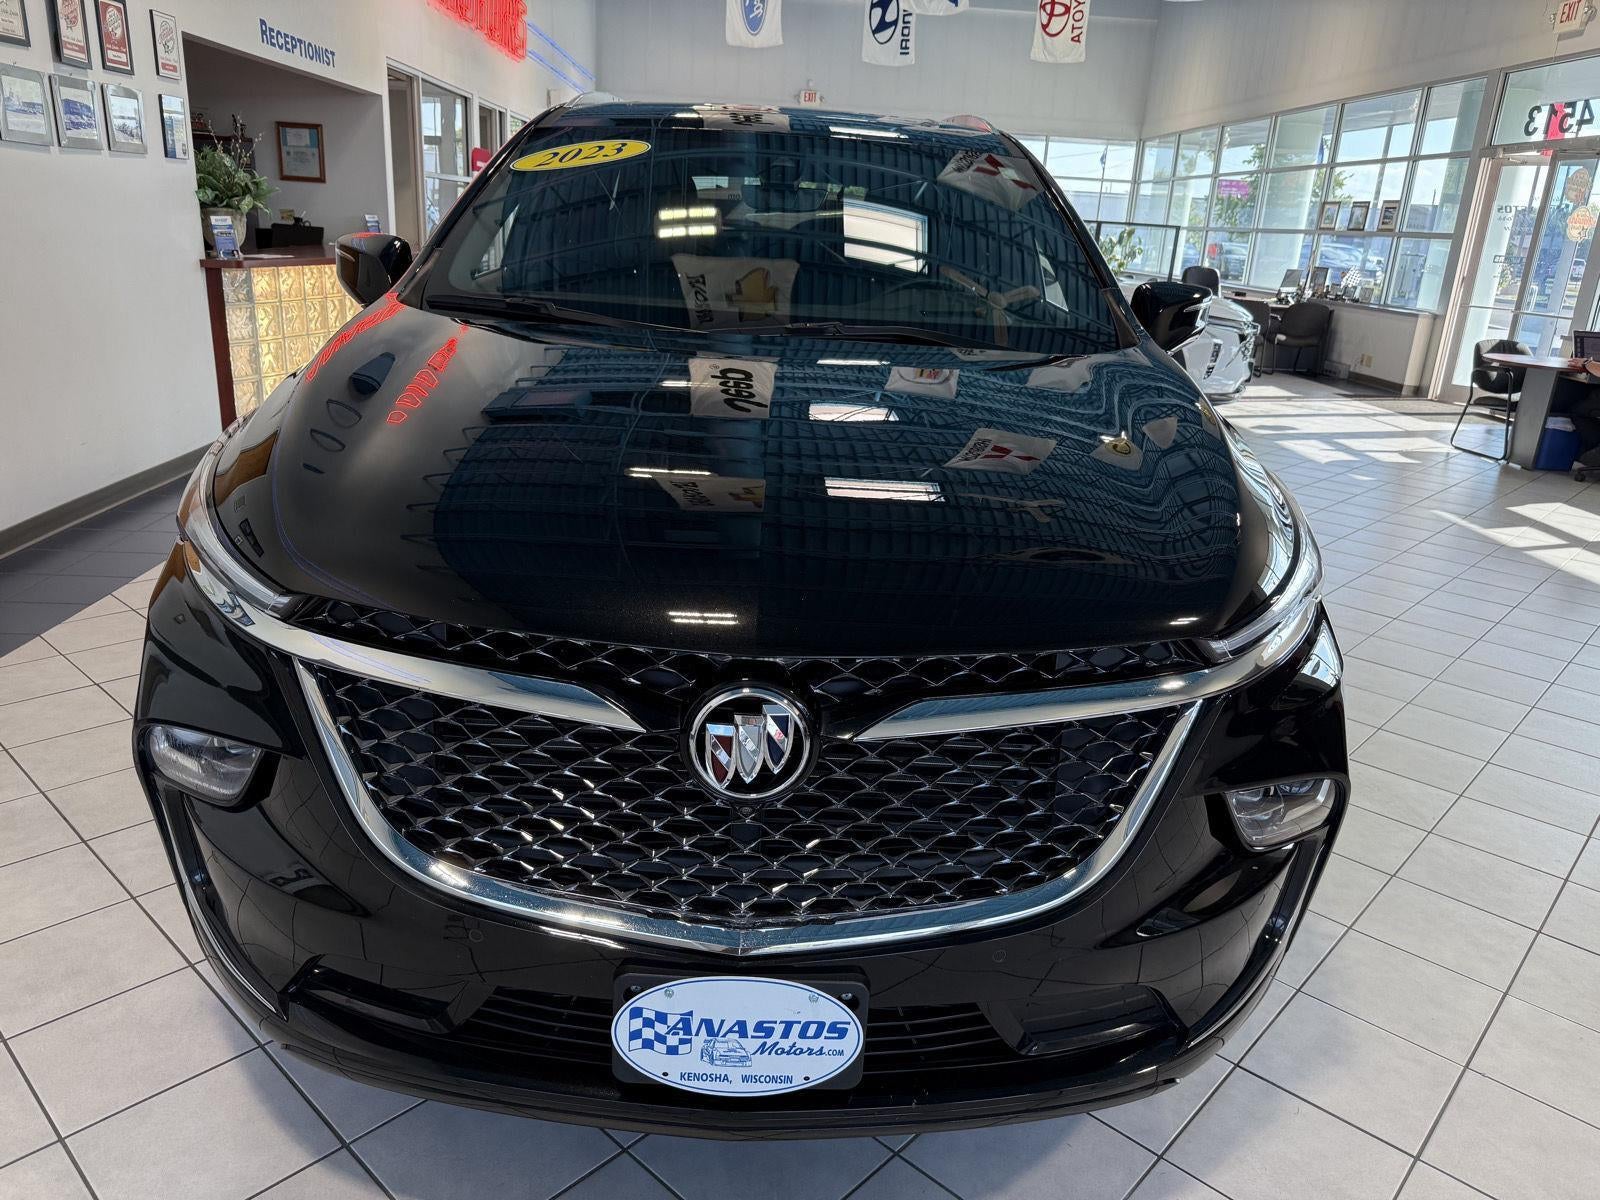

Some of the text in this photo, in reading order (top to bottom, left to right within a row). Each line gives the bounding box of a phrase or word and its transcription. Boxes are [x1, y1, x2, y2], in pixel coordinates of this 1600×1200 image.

[1559, 0, 1581, 23] EXIT
[259, 18, 336, 68] RECEPTIONIST
[804, 91, 817, 103] EXIT
[534, 143, 628, 168] 2023
[665, 1016, 850, 1040] ANASTOS
[680, 1072, 793, 1085] KENOSHA, WISCONSIN
